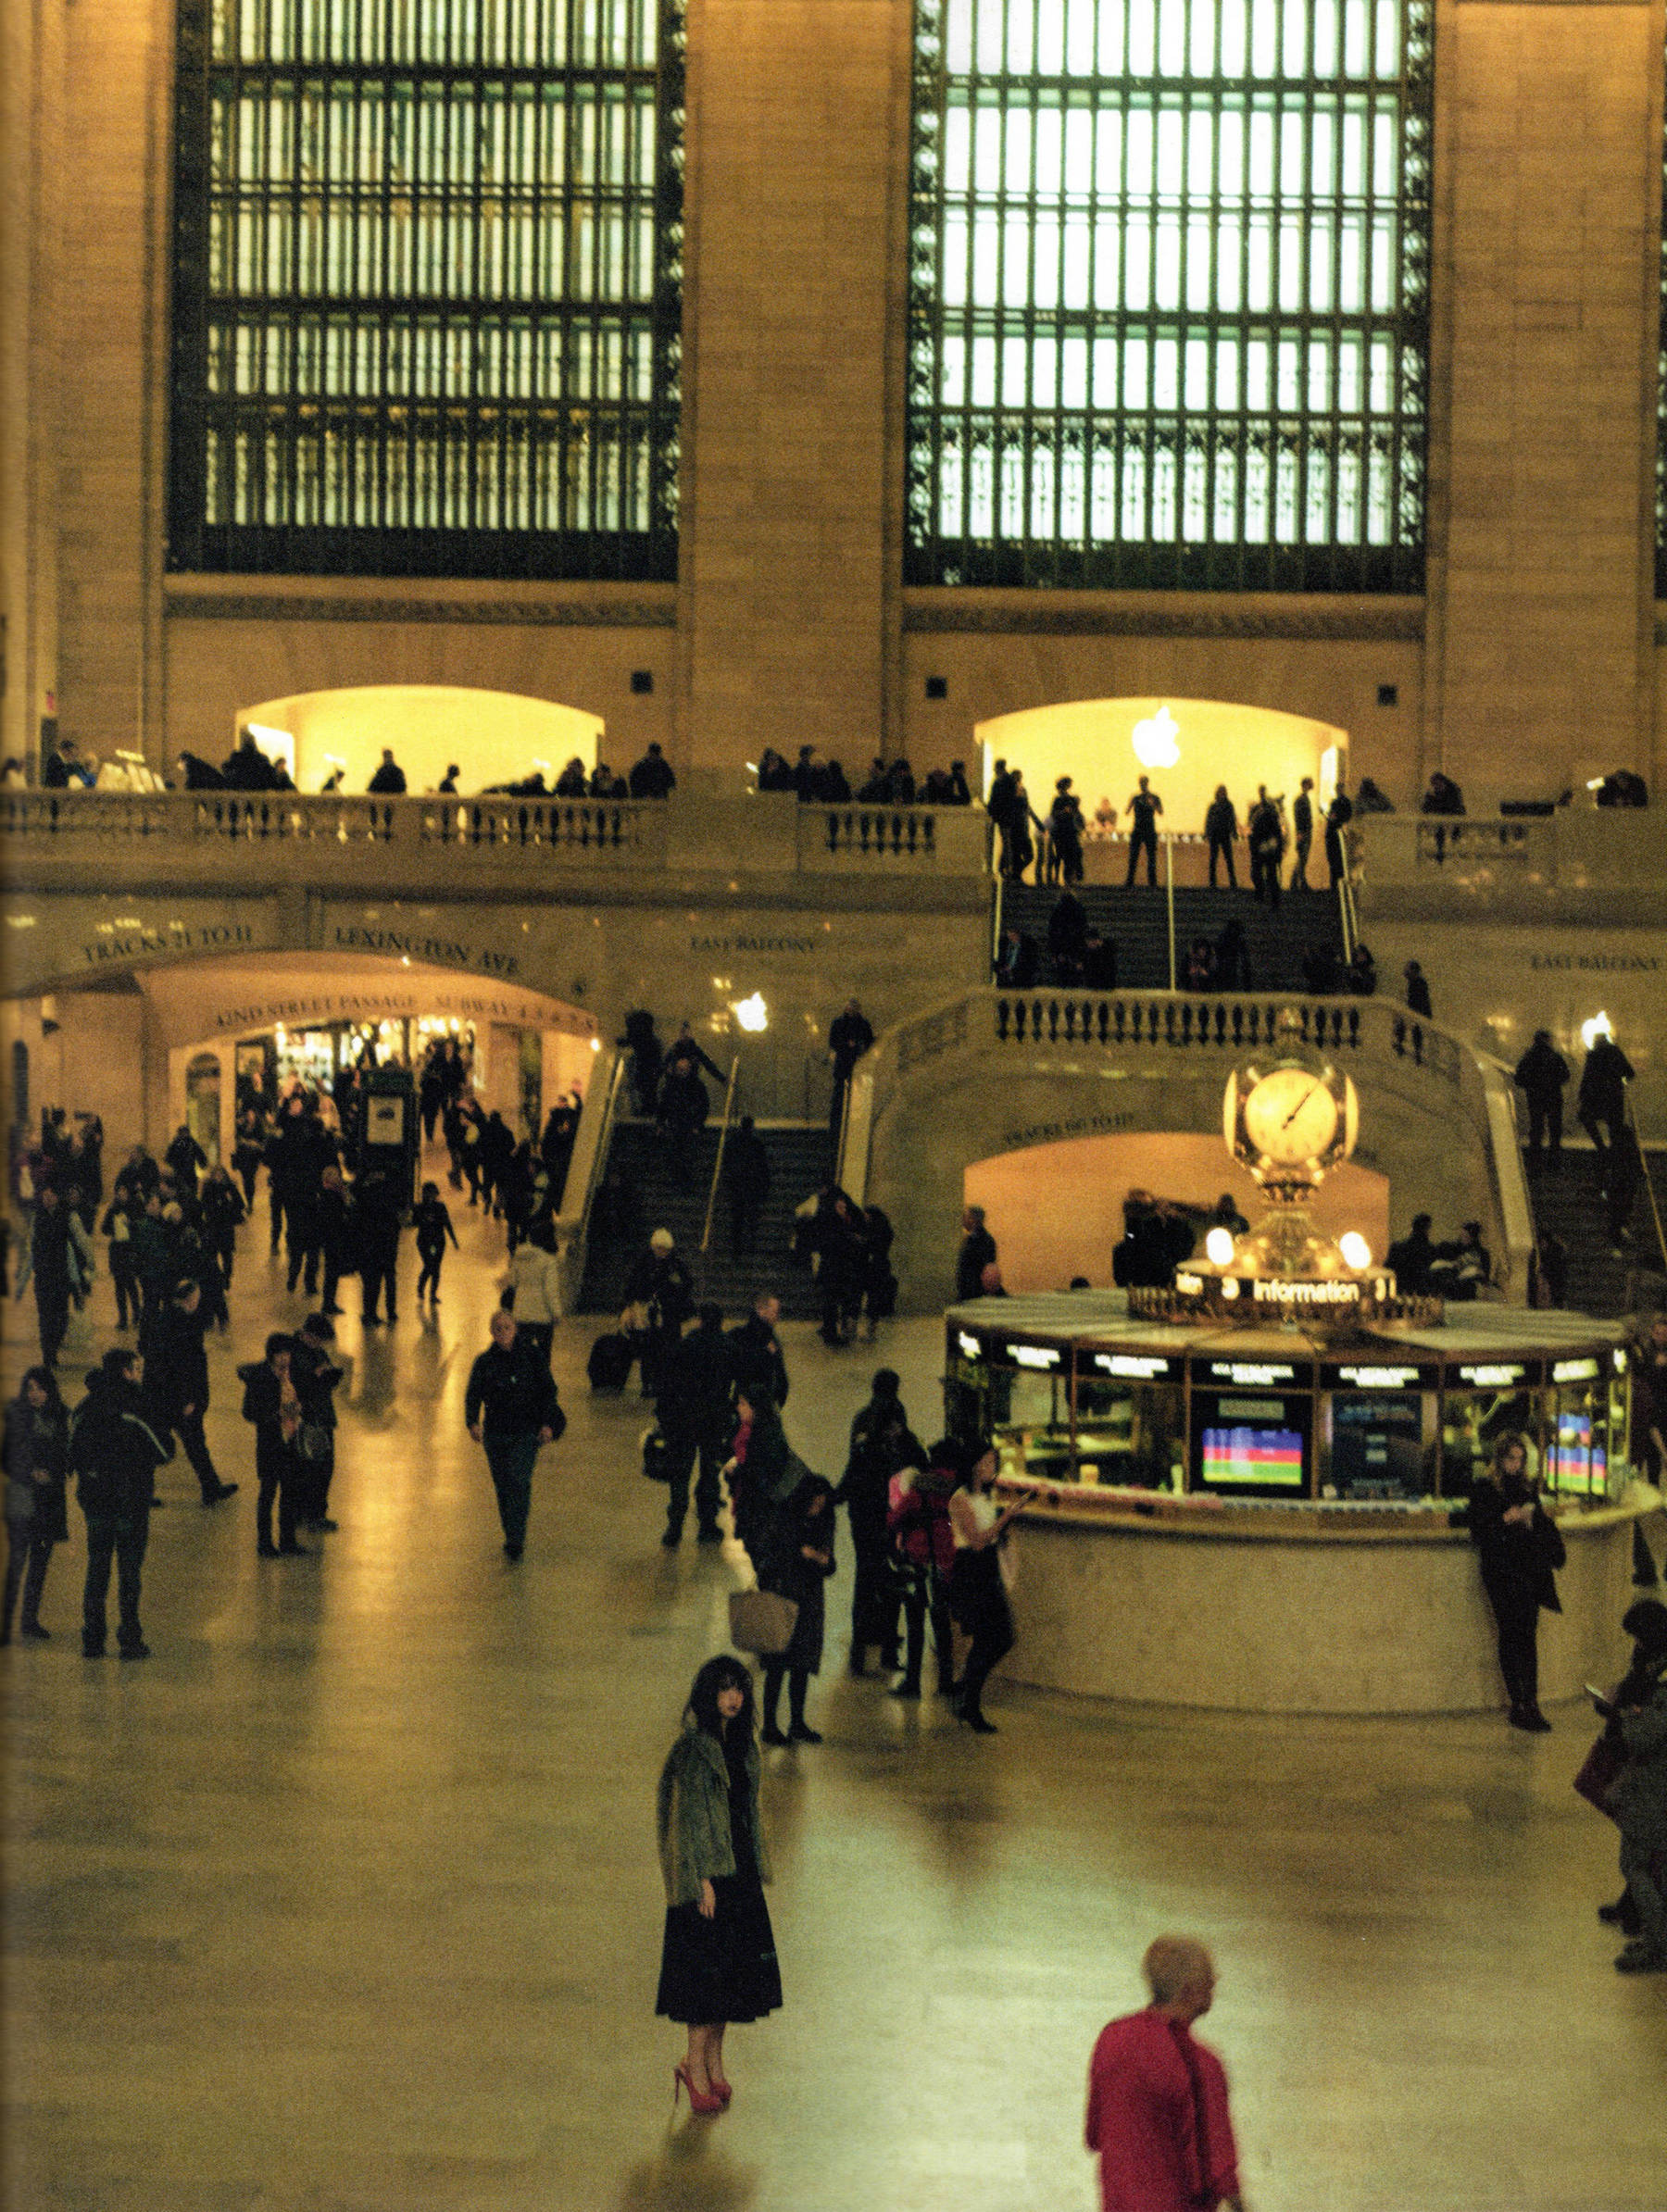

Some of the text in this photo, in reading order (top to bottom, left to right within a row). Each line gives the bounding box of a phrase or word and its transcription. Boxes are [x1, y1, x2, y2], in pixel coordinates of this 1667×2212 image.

[81, 933, 168, 963] TRACKS
[199, 927, 230, 945] TO
[334, 926, 519, 973] LEXINGTON AVE
[267, 997, 332, 1016] STREET
[1253, 1277, 1360, 1303] Information
